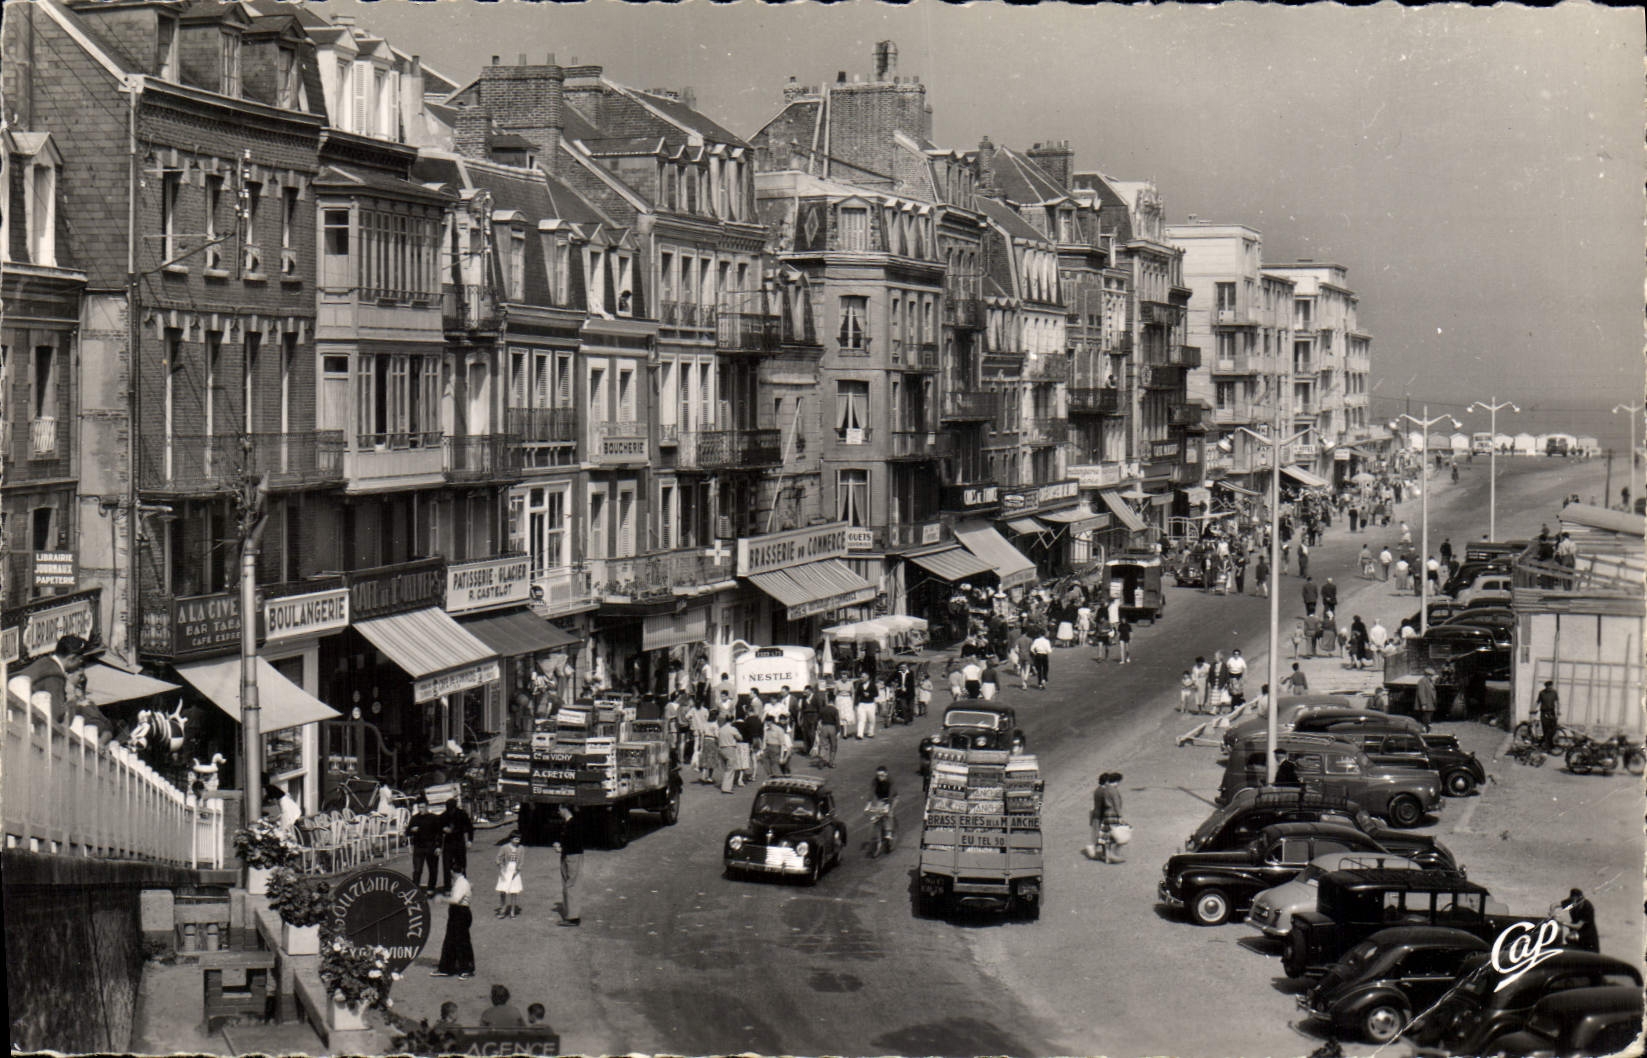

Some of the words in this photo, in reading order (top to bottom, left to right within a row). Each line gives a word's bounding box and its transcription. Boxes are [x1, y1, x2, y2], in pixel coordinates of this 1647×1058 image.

[603, 442, 644, 454] BOUCHERIE
[36, 553, 73, 562] LIBRAIRIE
[749, 540, 795, 570] BRASSERIE
[807, 530, 846, 557] COMMERCE
[36, 576, 75, 585] PAPETERIE
[453, 567, 493, 590] PATISSERIE
[178, 605, 185, 624] A
[189, 602, 205, 623] LA
[207, 594, 262, 620] CIVEE
[269, 596, 345, 633] BOULANGERIE
[186, 623, 208, 636] BAR
[214, 619, 242, 633] TABA
[551, 753, 573, 761] VICHY
[961, 835, 974, 845] EU
[978, 836, 991, 846] TEL
[398, 888, 423, 939] Azur
[465, 1041, 556, 1056] AGENCE
